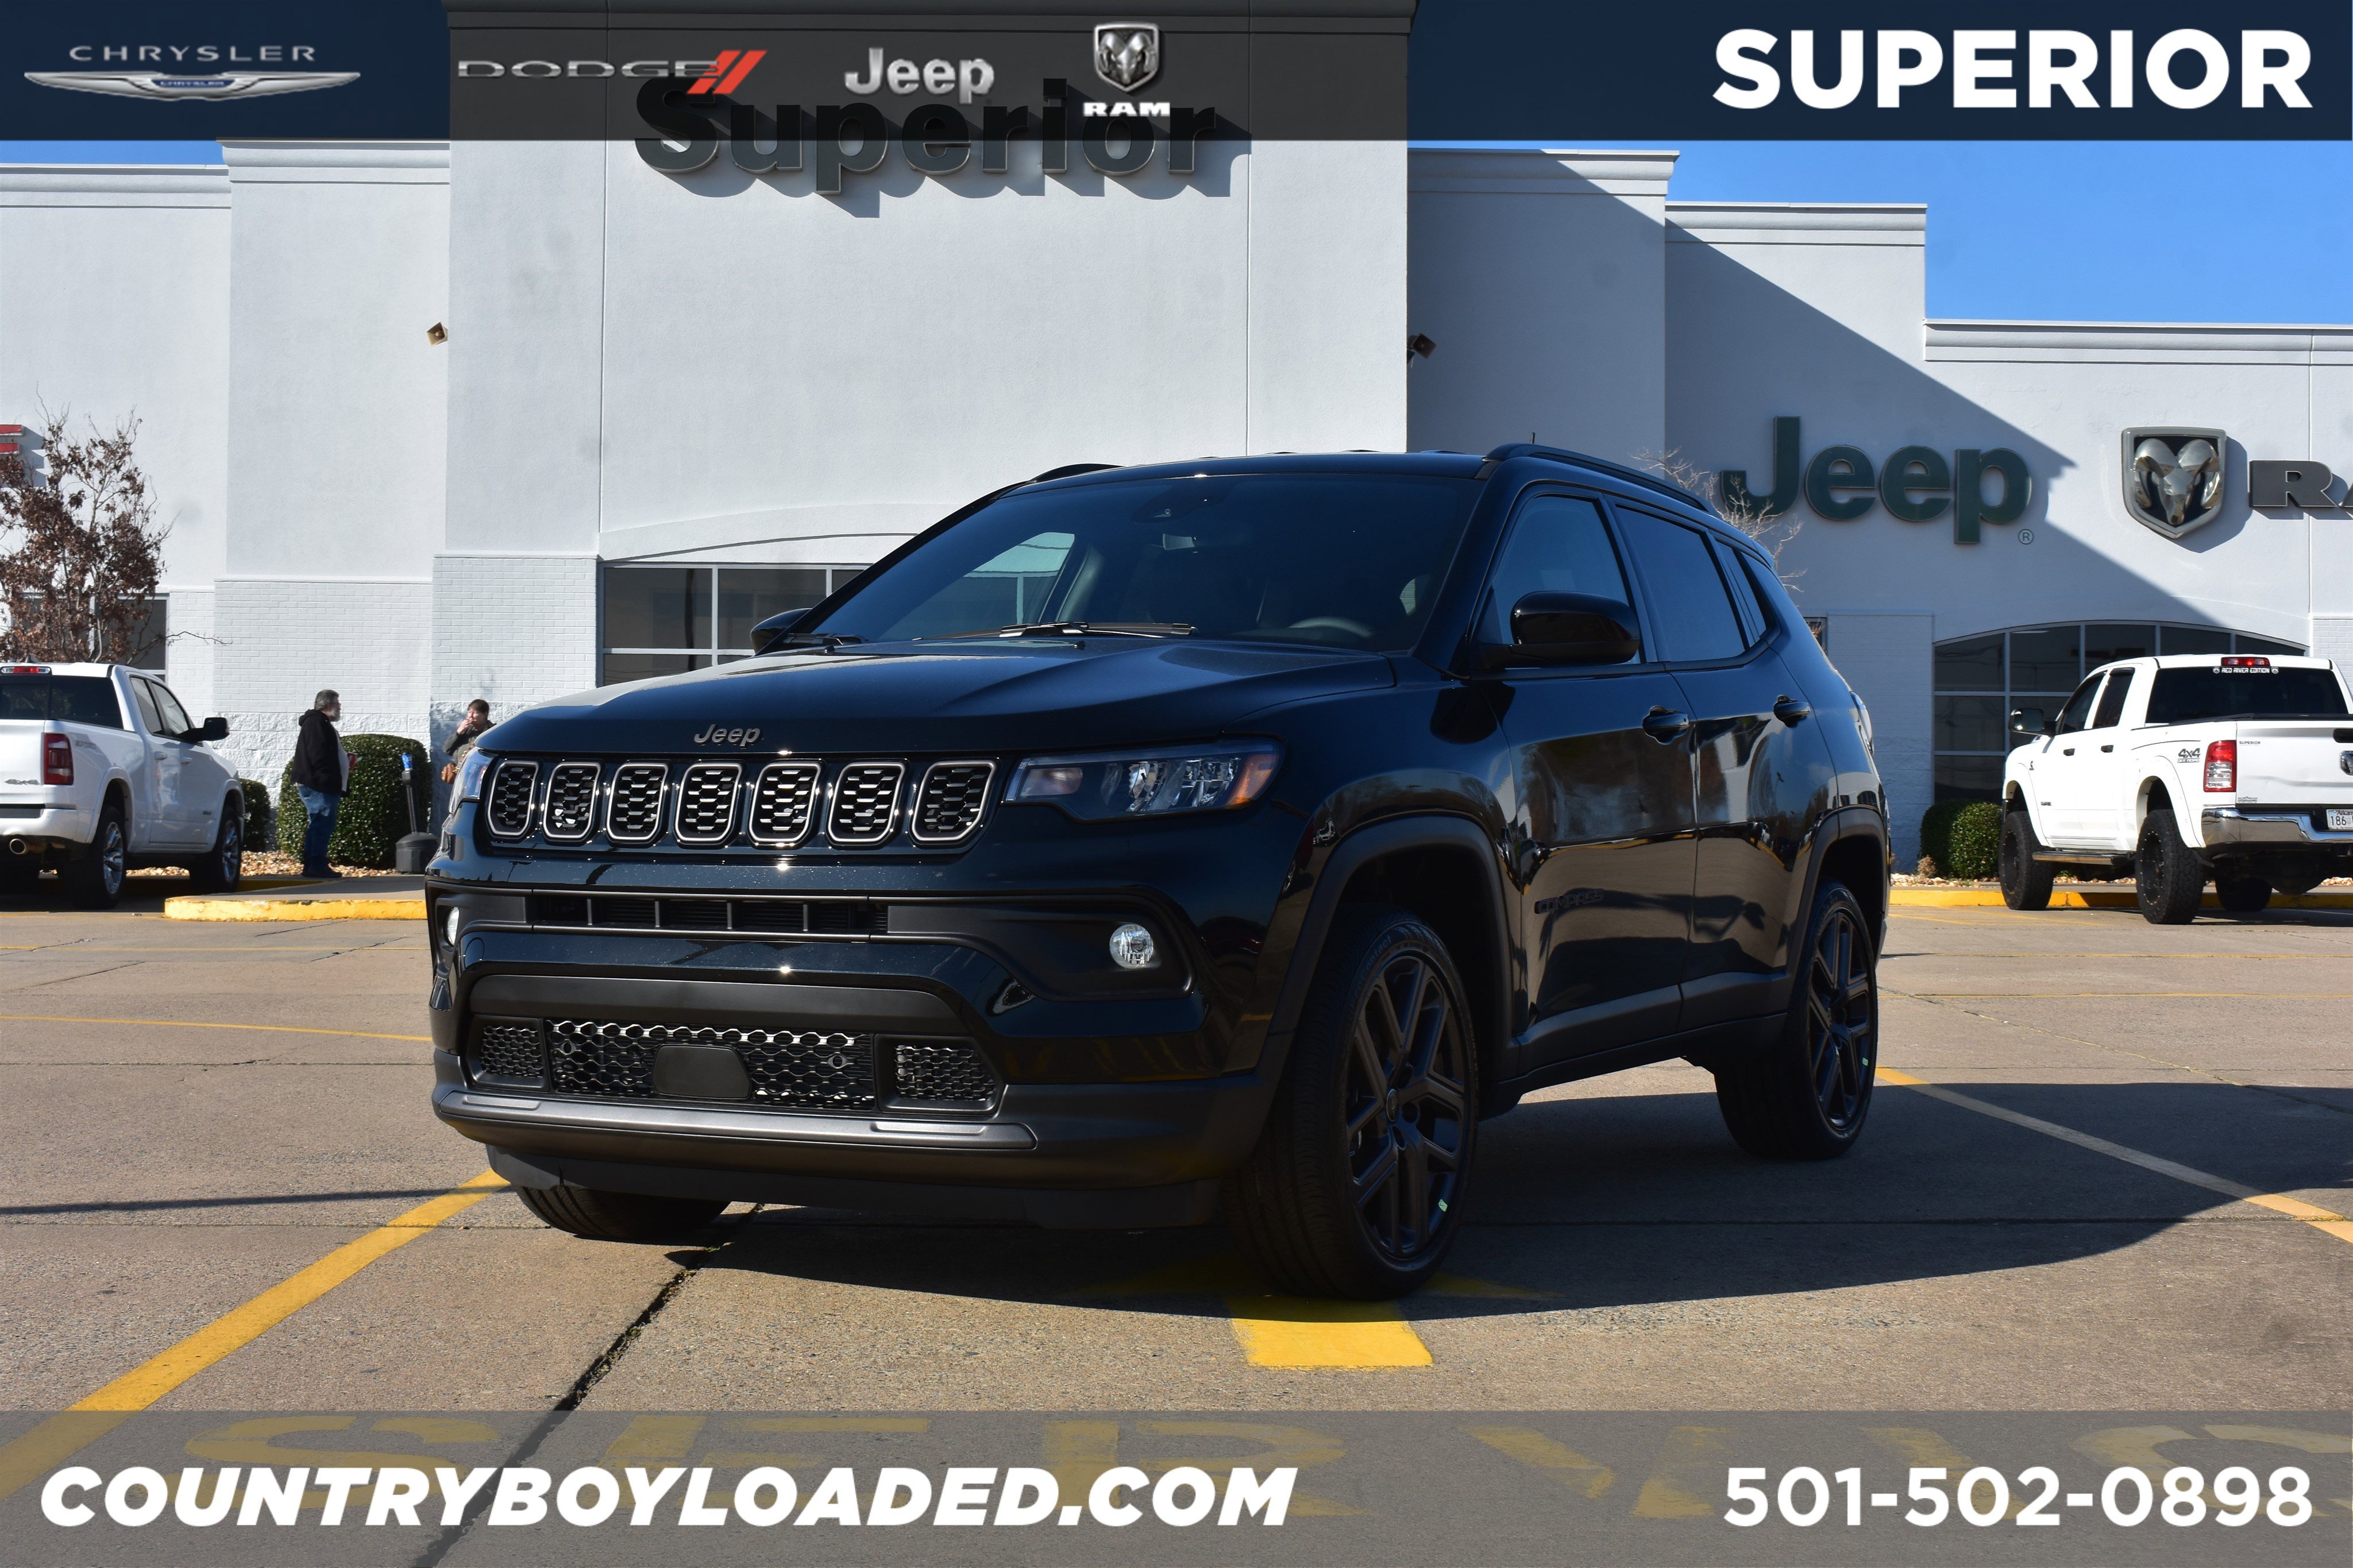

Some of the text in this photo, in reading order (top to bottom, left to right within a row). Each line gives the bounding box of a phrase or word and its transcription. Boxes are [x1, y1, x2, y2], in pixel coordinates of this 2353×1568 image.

[634, 75, 1216, 195] Superior
[1719, 415, 2034, 544] Jeep
[2248, 460, 2353, 508] R
[693, 724, 761, 747] Jeep
[2331, 816, 2347, 826] 186
